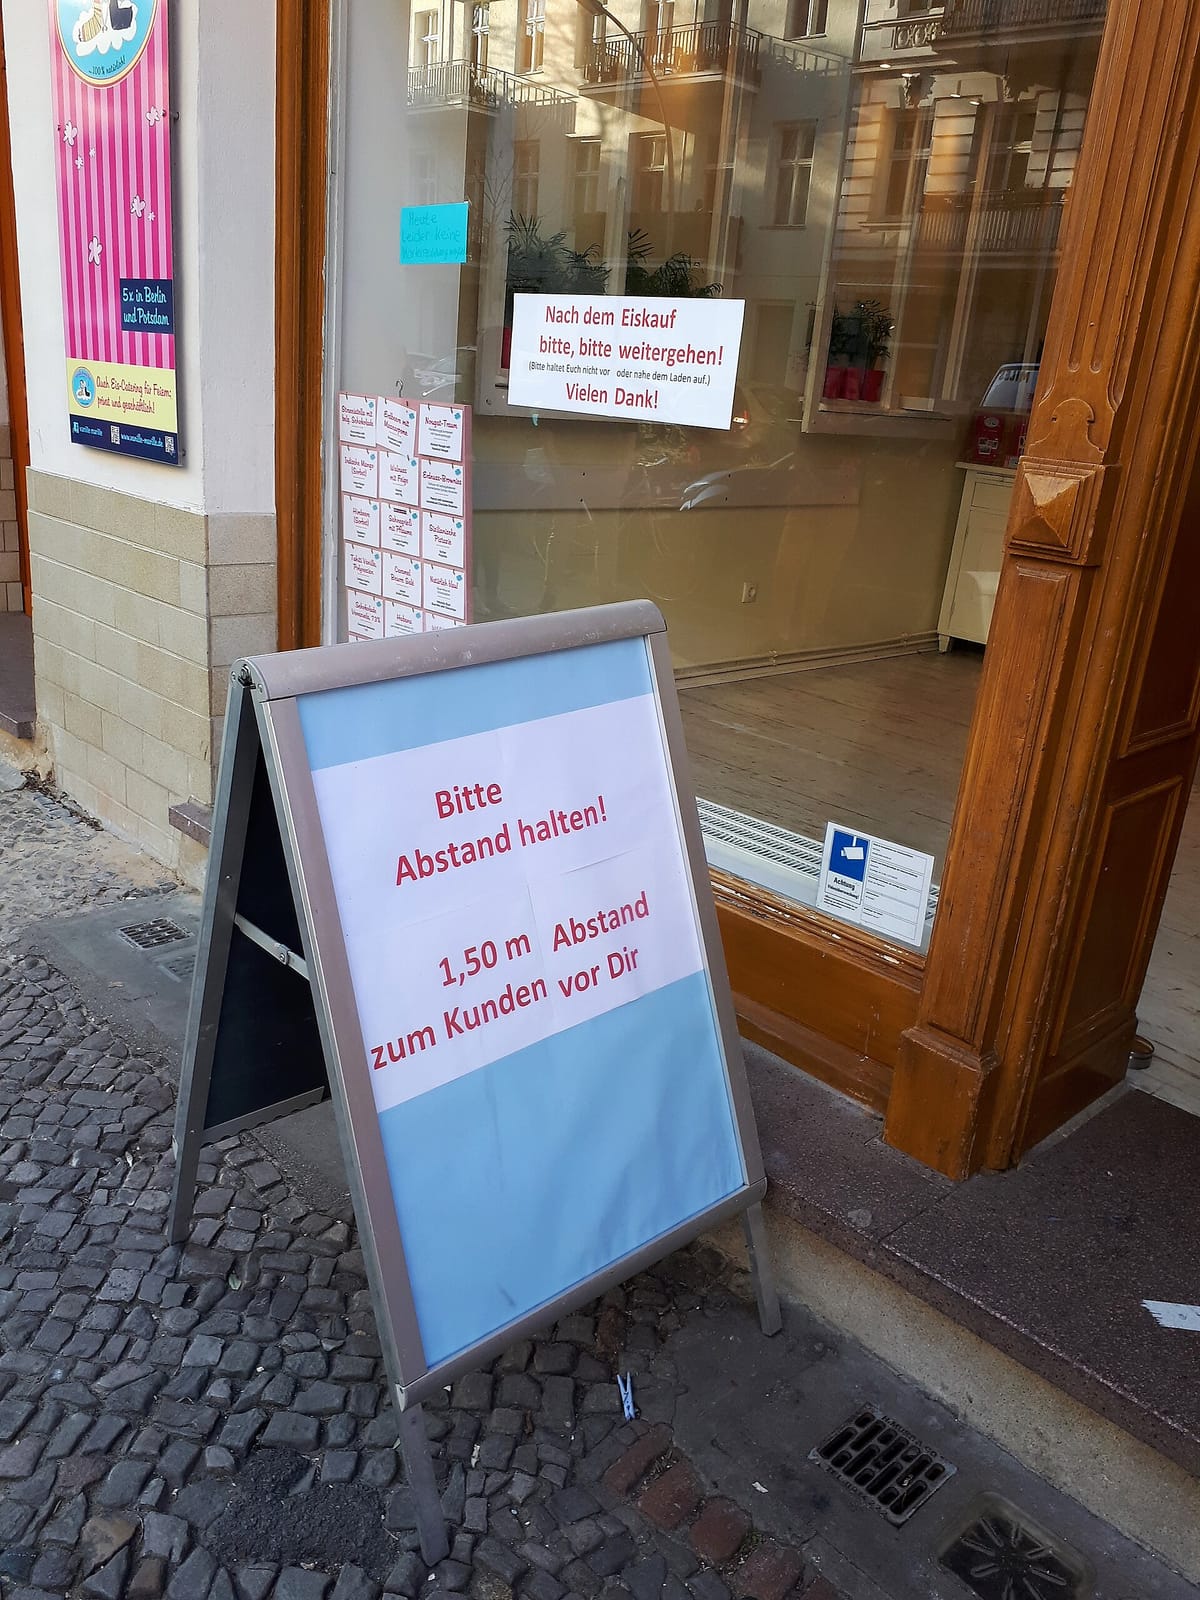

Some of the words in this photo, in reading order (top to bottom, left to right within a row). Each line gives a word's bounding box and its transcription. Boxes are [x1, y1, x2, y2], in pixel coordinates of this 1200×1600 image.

[123, 288, 134, 301] 5x
[136, 289, 143, 302] in
[144, 285, 167, 303] Berlin
[124, 306, 137, 323] und
[137, 308, 169, 325] Potsdam
[545, 305, 579, 325] Nach
[584, 306, 614, 326] dem
[621, 308, 677, 328] Eiskauf
[539, 335, 575, 358] bitte,
[579, 337, 612, 357] bitte
[619, 341, 723, 366] weitergehen!
[96, 376, 110, 389] Auch
[144, 380, 152, 395] für
[529, 361, 545, 371] (Bitte
[546, 362, 565, 373] haltet
[566, 364, 581, 374] Euch
[582, 366, 598, 375] nicht
[616, 369, 632, 378] oder
[634, 370, 651, 380] nahe
[652, 371, 668, 381] dem
[670, 372, 692, 383] Laden
[693, 374, 711, 386] auf.)
[111, 396, 121, 407] und
[566, 382, 608, 404] Vielen
[614, 387, 658, 409] Dank!
[434, 782, 503, 820] Bitte
[396, 823, 512, 886] Abstand
[518, 795, 607, 847] halten!
[833, 877, 855, 891] Achtung
[438, 940, 498, 988] 1,50
[505, 932, 531, 961] m
[552, 890, 650, 952] Abstand
[370, 1023, 436, 1070] zum
[443, 976, 548, 1040] Kunden
[558, 964, 600, 998] vor
[606, 945, 639, 980] Dir
